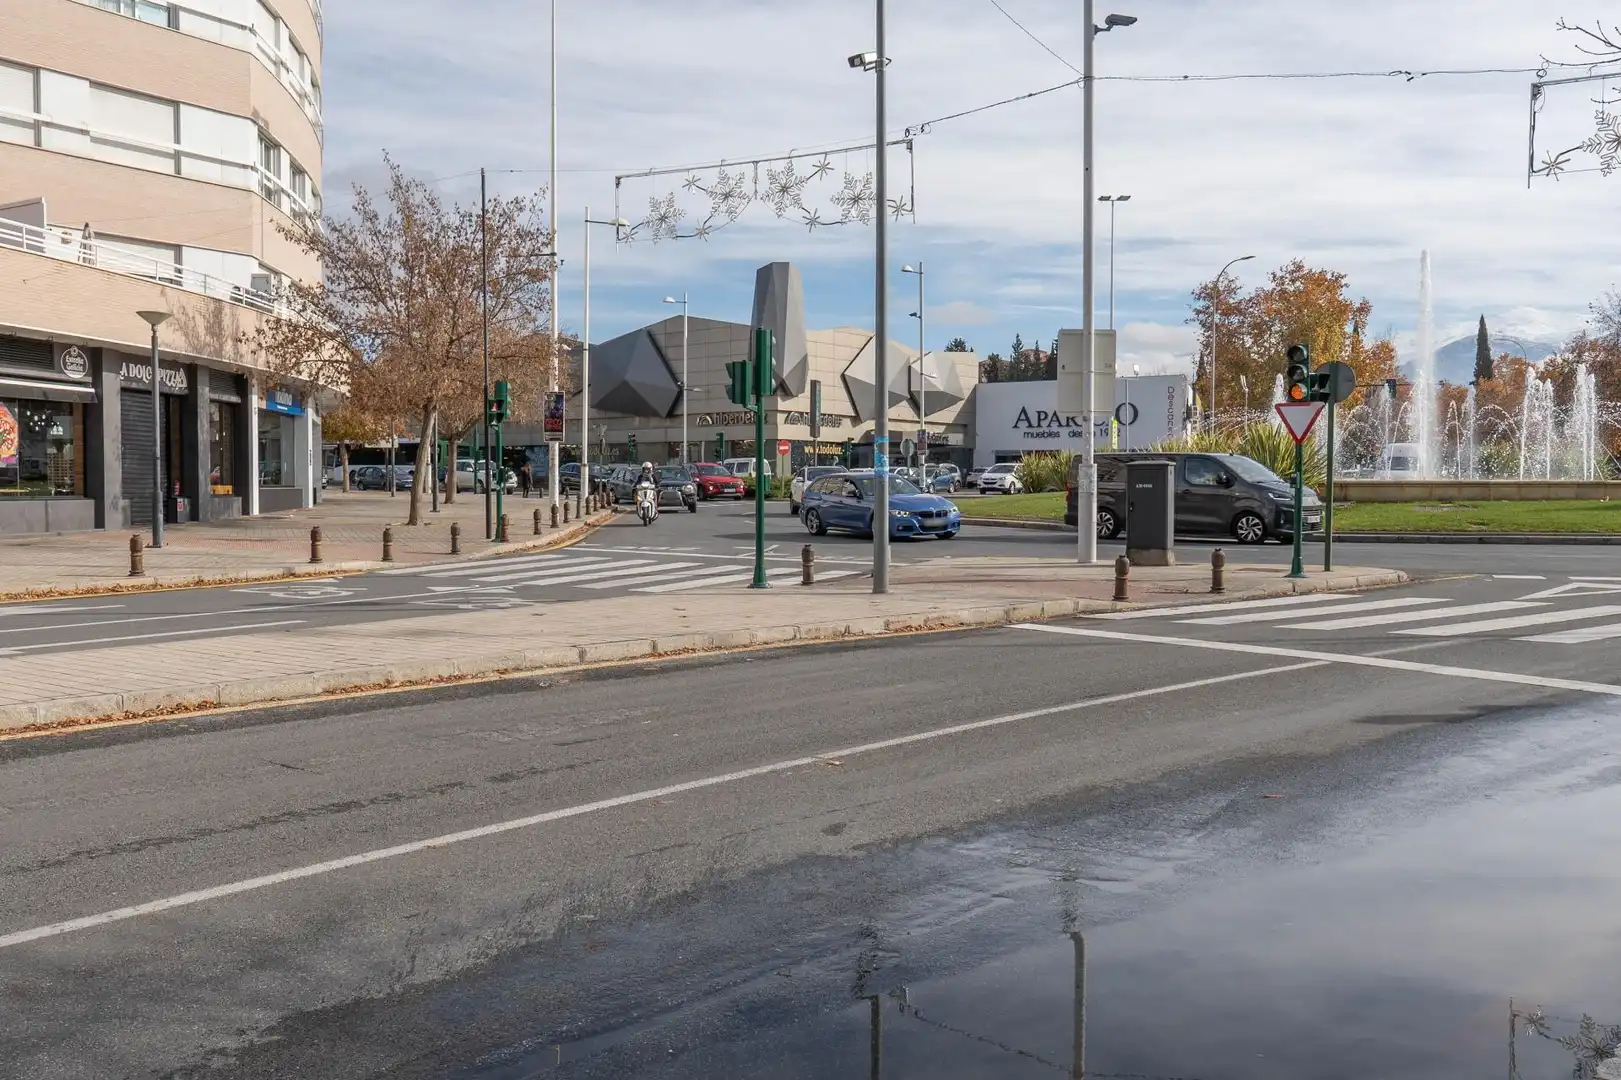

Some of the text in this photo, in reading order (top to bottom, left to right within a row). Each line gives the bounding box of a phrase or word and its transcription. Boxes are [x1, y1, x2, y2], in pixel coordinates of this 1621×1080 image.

[120, 362, 128, 379] A
[129, 363, 153, 383] DOLC
[1023, 429, 1060, 439] muebles
